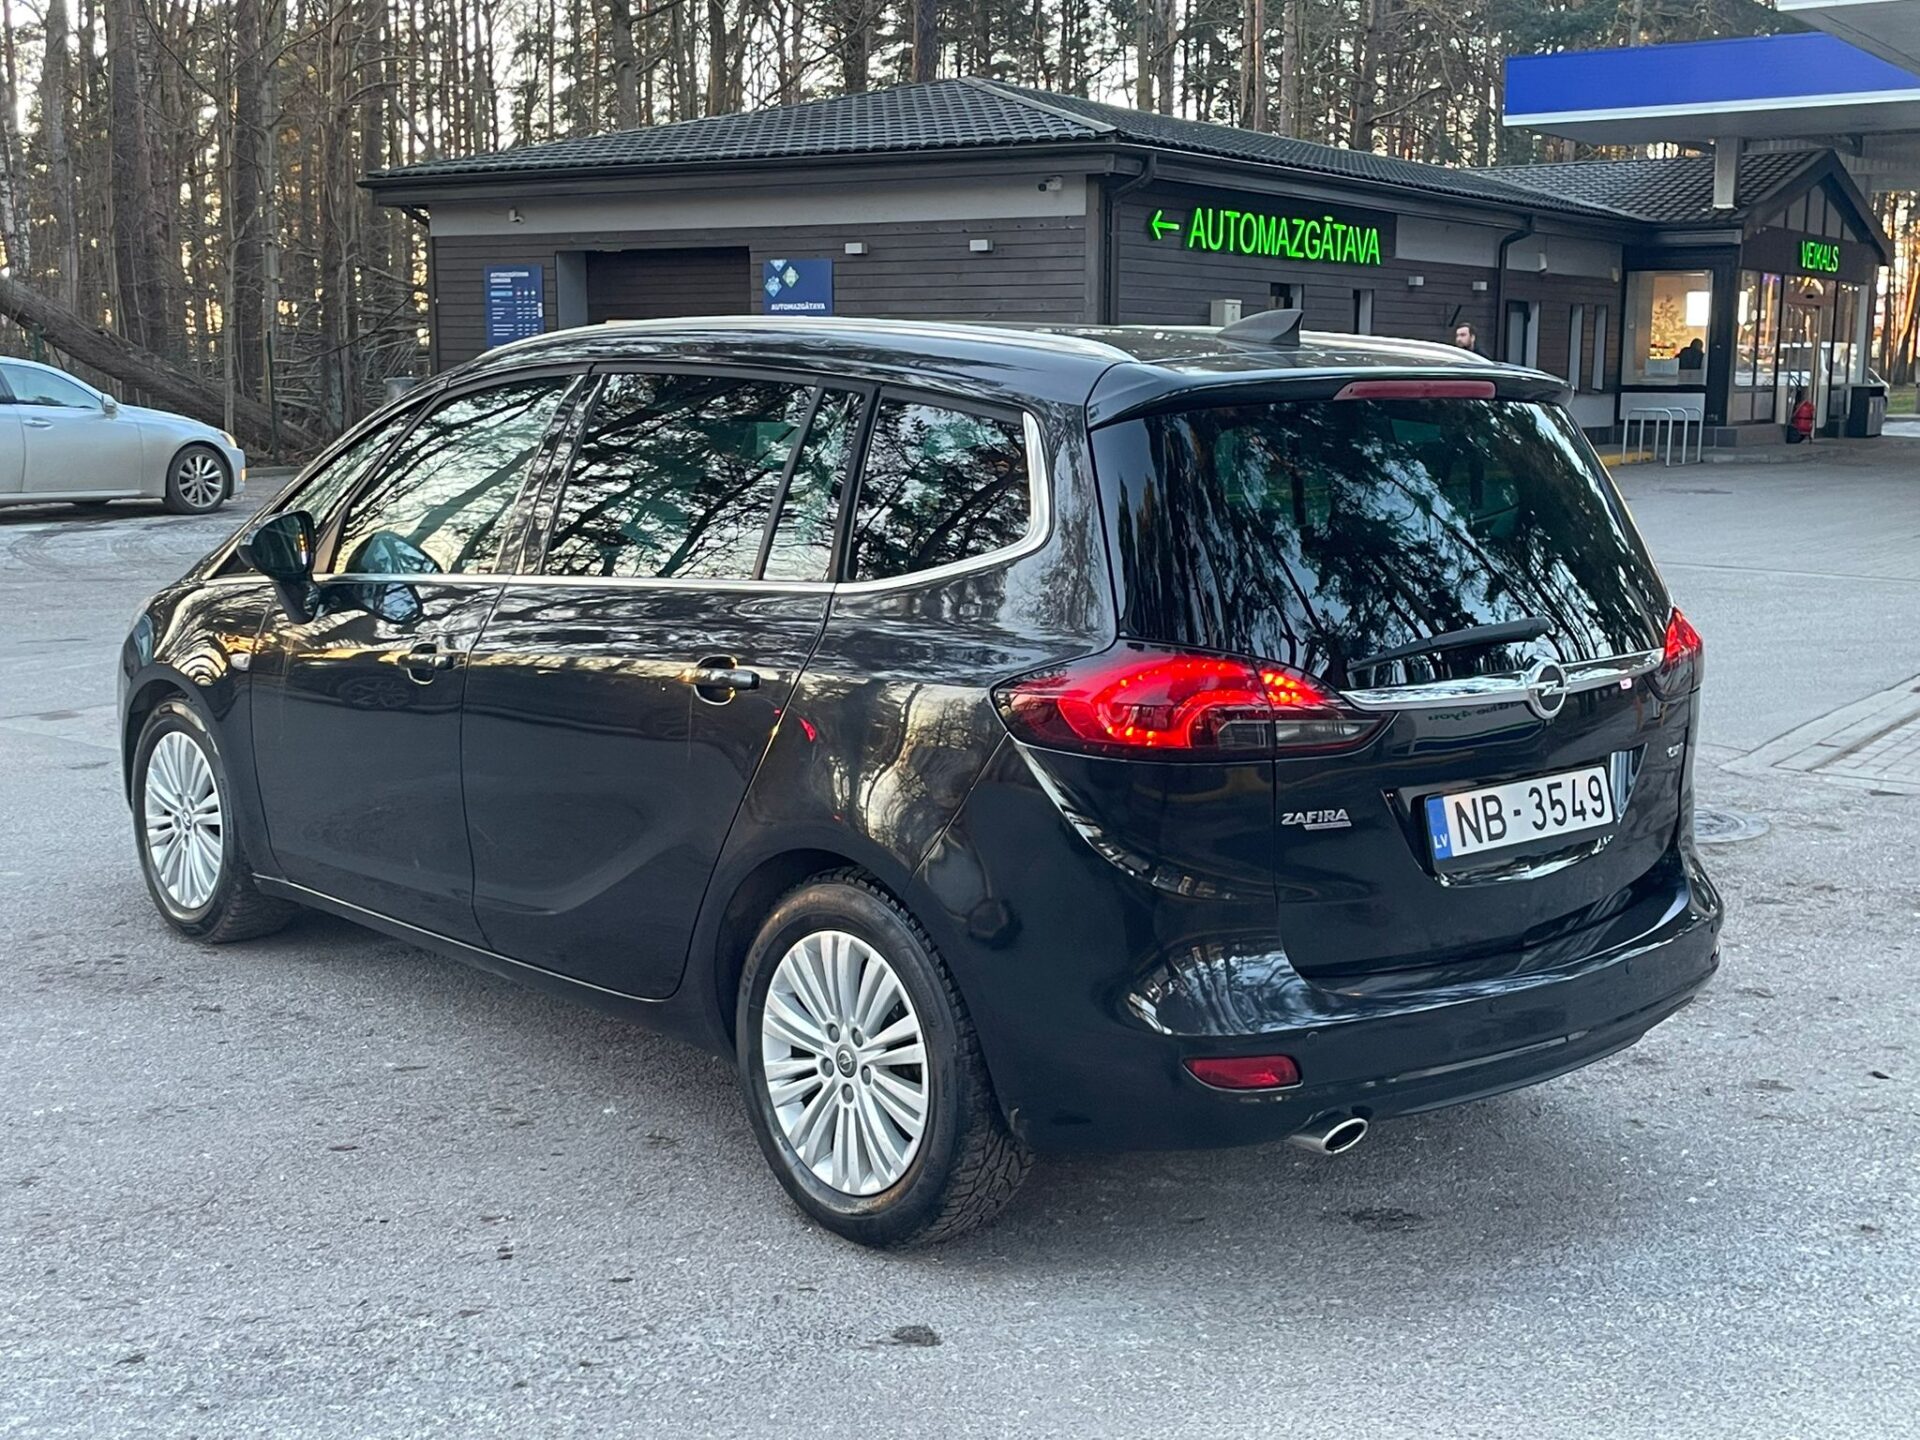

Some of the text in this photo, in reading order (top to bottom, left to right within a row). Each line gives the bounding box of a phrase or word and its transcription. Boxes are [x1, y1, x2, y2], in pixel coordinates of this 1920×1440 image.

[1189, 207, 1381, 265] AUTOMAZGĀTAVA
[1801, 240, 1839, 273] VEIKALS
[1281, 808, 1349, 825] ZAFIRA
[1455, 775, 1606, 848] NB-3549
[1433, 833, 1448, 849] LV
